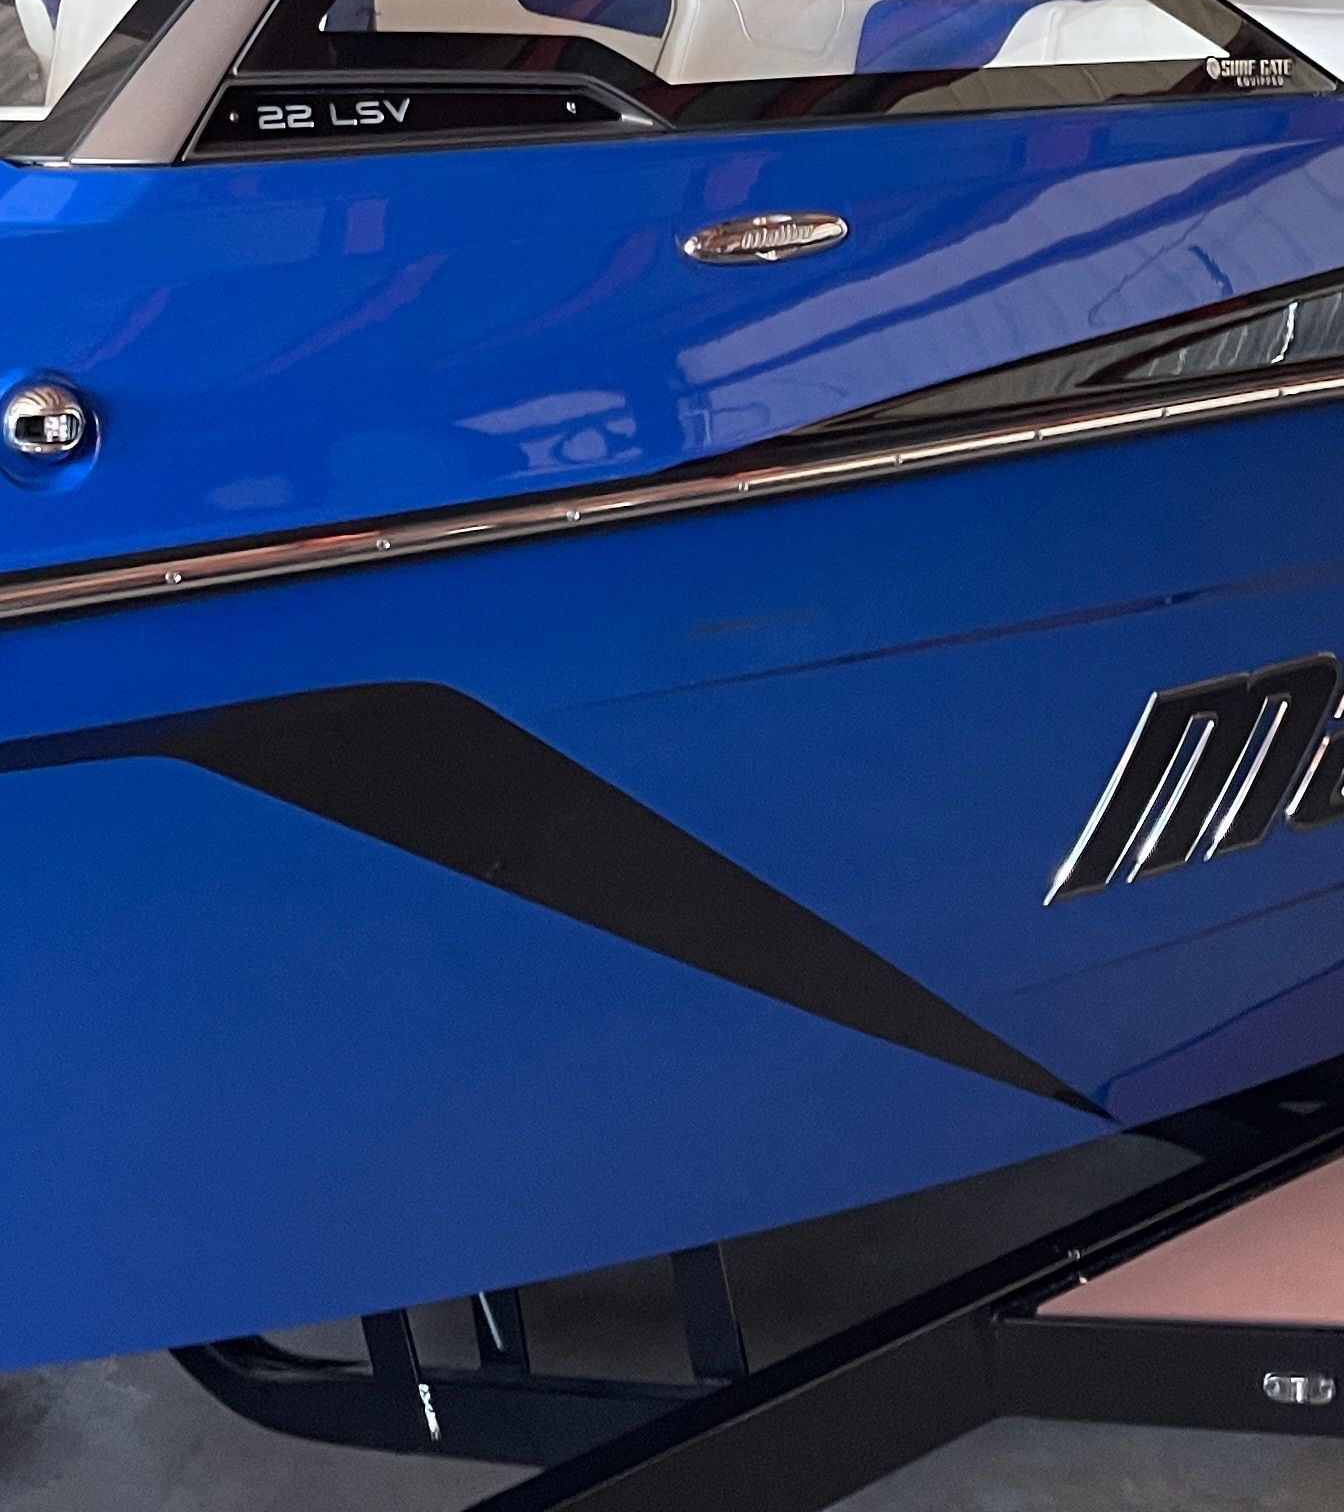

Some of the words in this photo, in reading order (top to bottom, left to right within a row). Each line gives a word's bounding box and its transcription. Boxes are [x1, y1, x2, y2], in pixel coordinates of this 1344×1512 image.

[1220, 59, 1256, 77] SURF
[1260, 58, 1294, 76] GATE
[257, 104, 315, 130] 22
[329, 97, 410, 126] LSV
